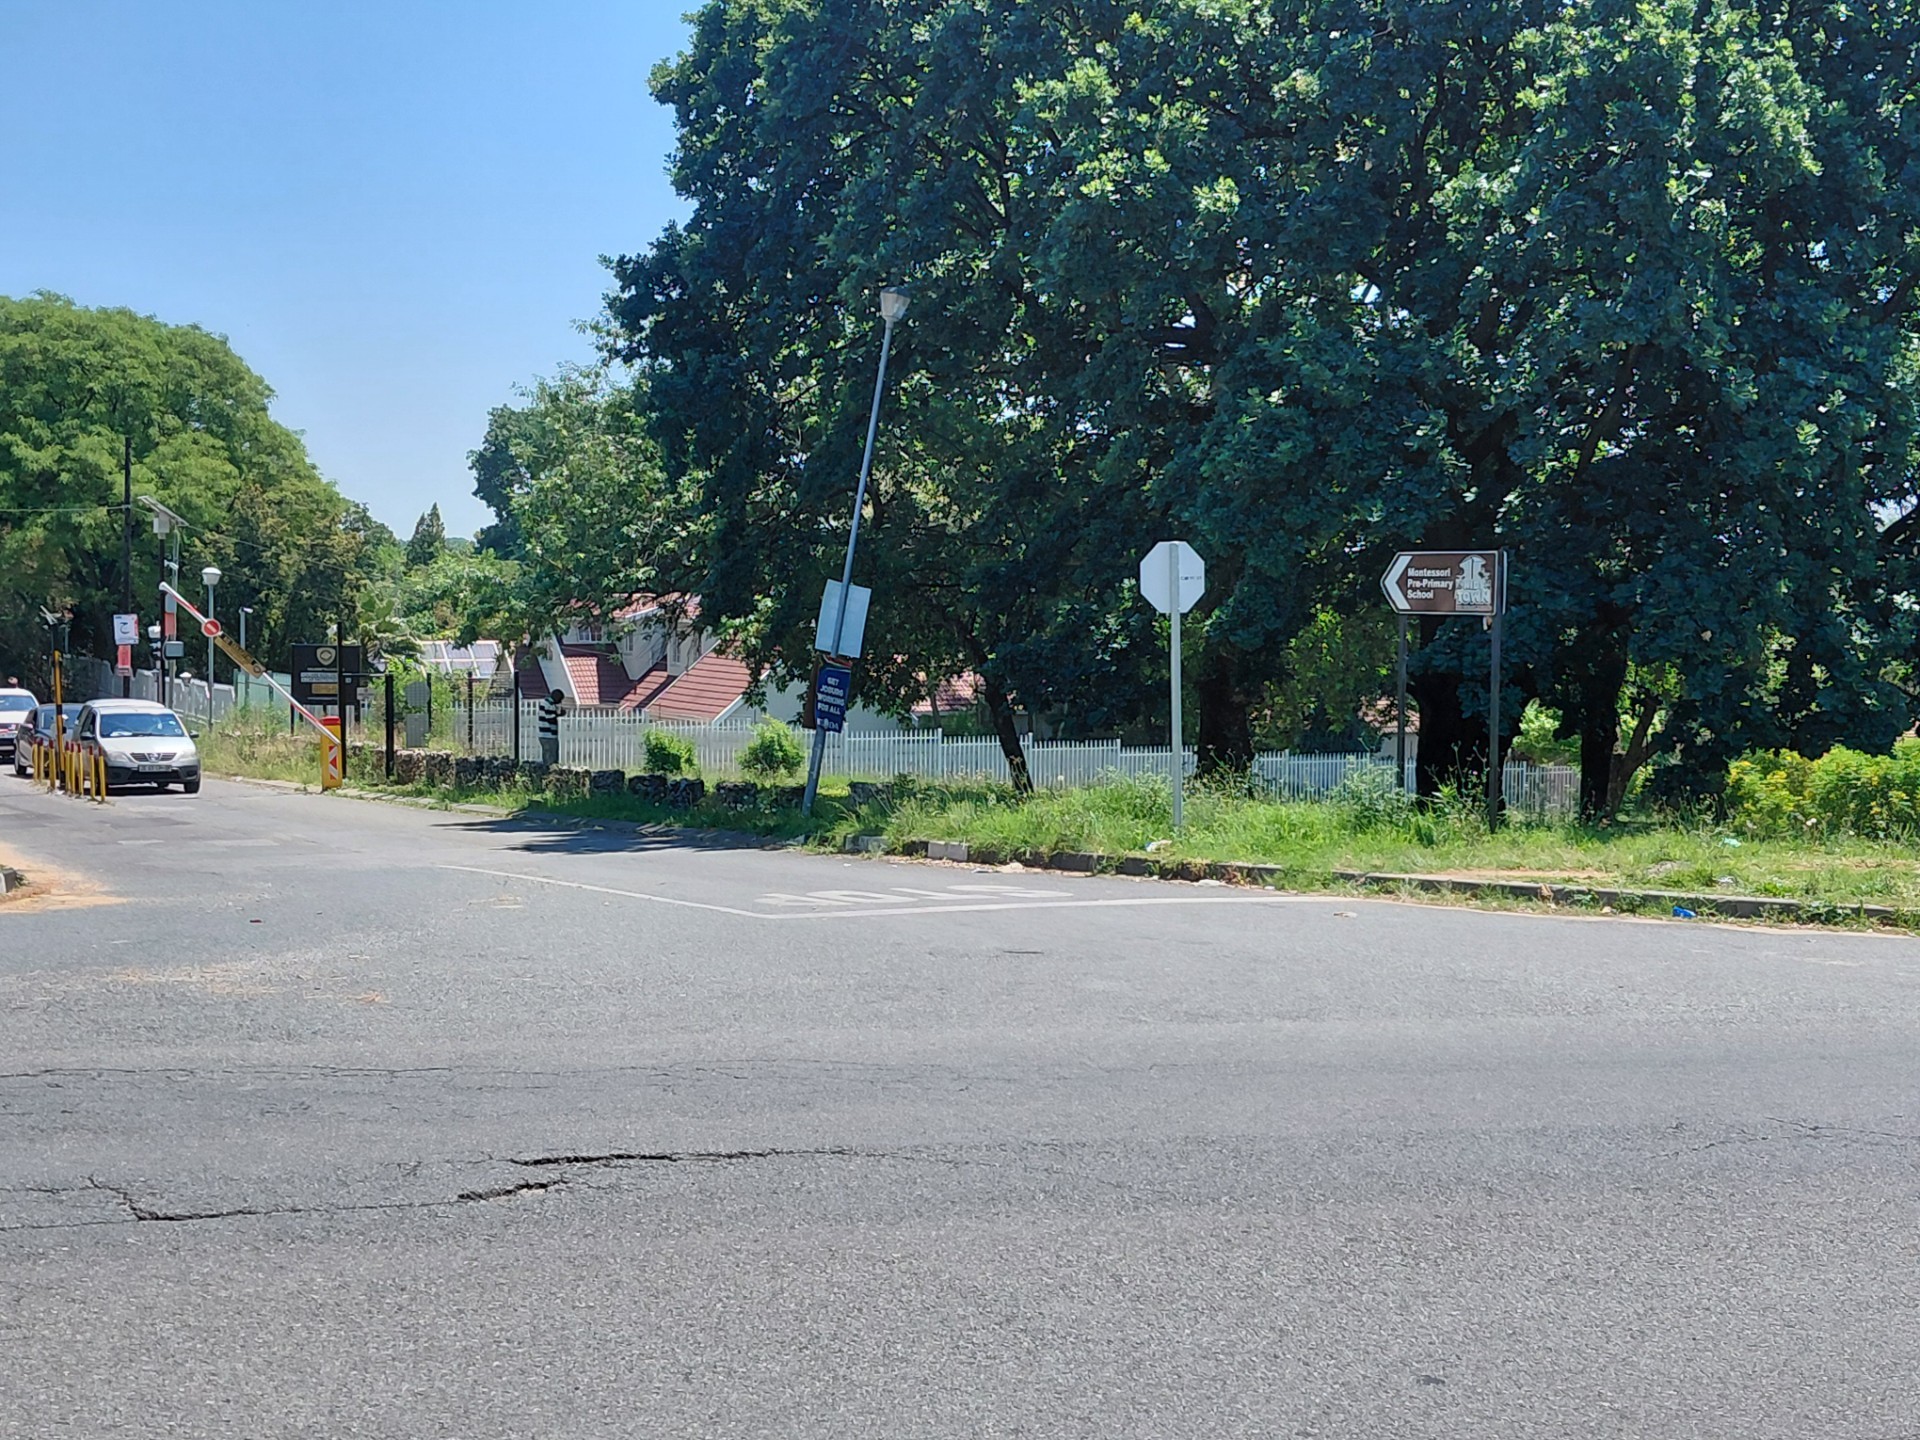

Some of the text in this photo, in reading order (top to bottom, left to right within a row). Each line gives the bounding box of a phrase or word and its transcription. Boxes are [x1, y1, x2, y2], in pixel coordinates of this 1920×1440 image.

[1407, 567, 1451, 577] Montessori
[1407, 578, 1454, 590] Pre-Primary
[1406, 589, 1434, 599] School
[1456, 589, 1491, 604] TOWN
[827, 677, 840, 686] GET
[817, 702, 841, 715] FOR ALL
